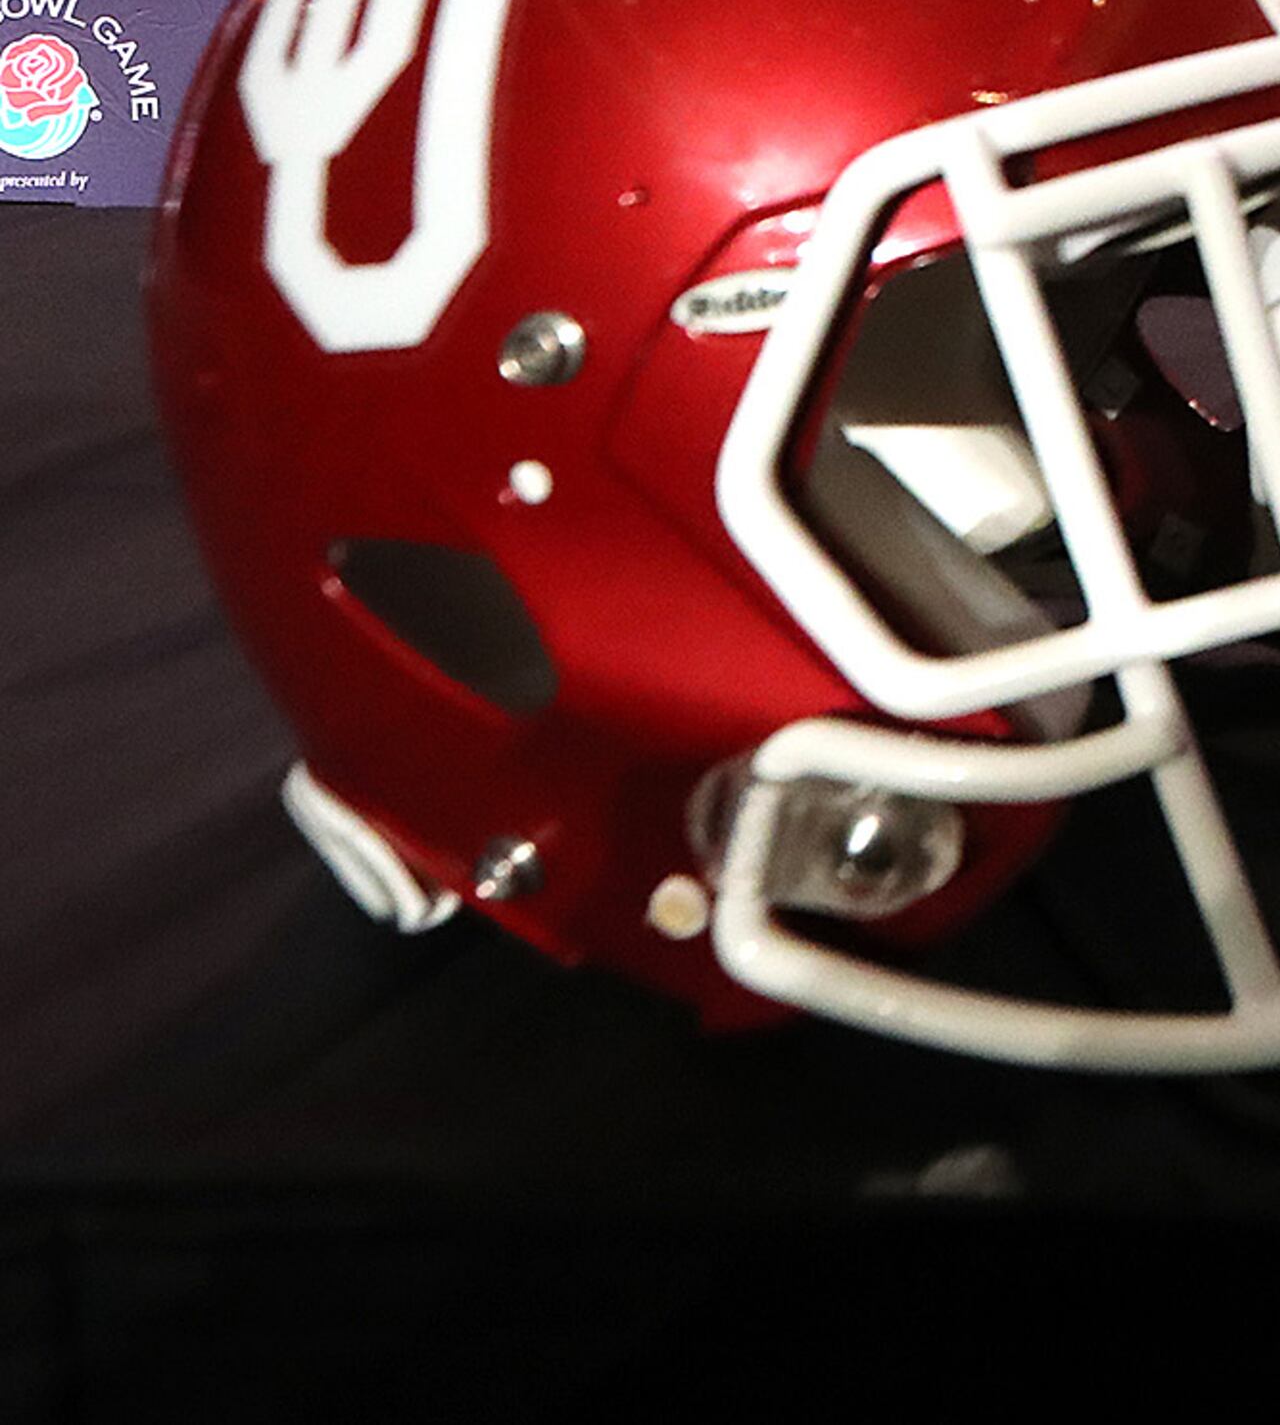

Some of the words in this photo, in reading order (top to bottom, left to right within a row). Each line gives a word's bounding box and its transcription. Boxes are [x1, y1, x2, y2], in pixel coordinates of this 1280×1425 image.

[93, 17, 158, 121] GAME
[1, 172, 66, 190] presented
[71, 172, 88, 191] by
